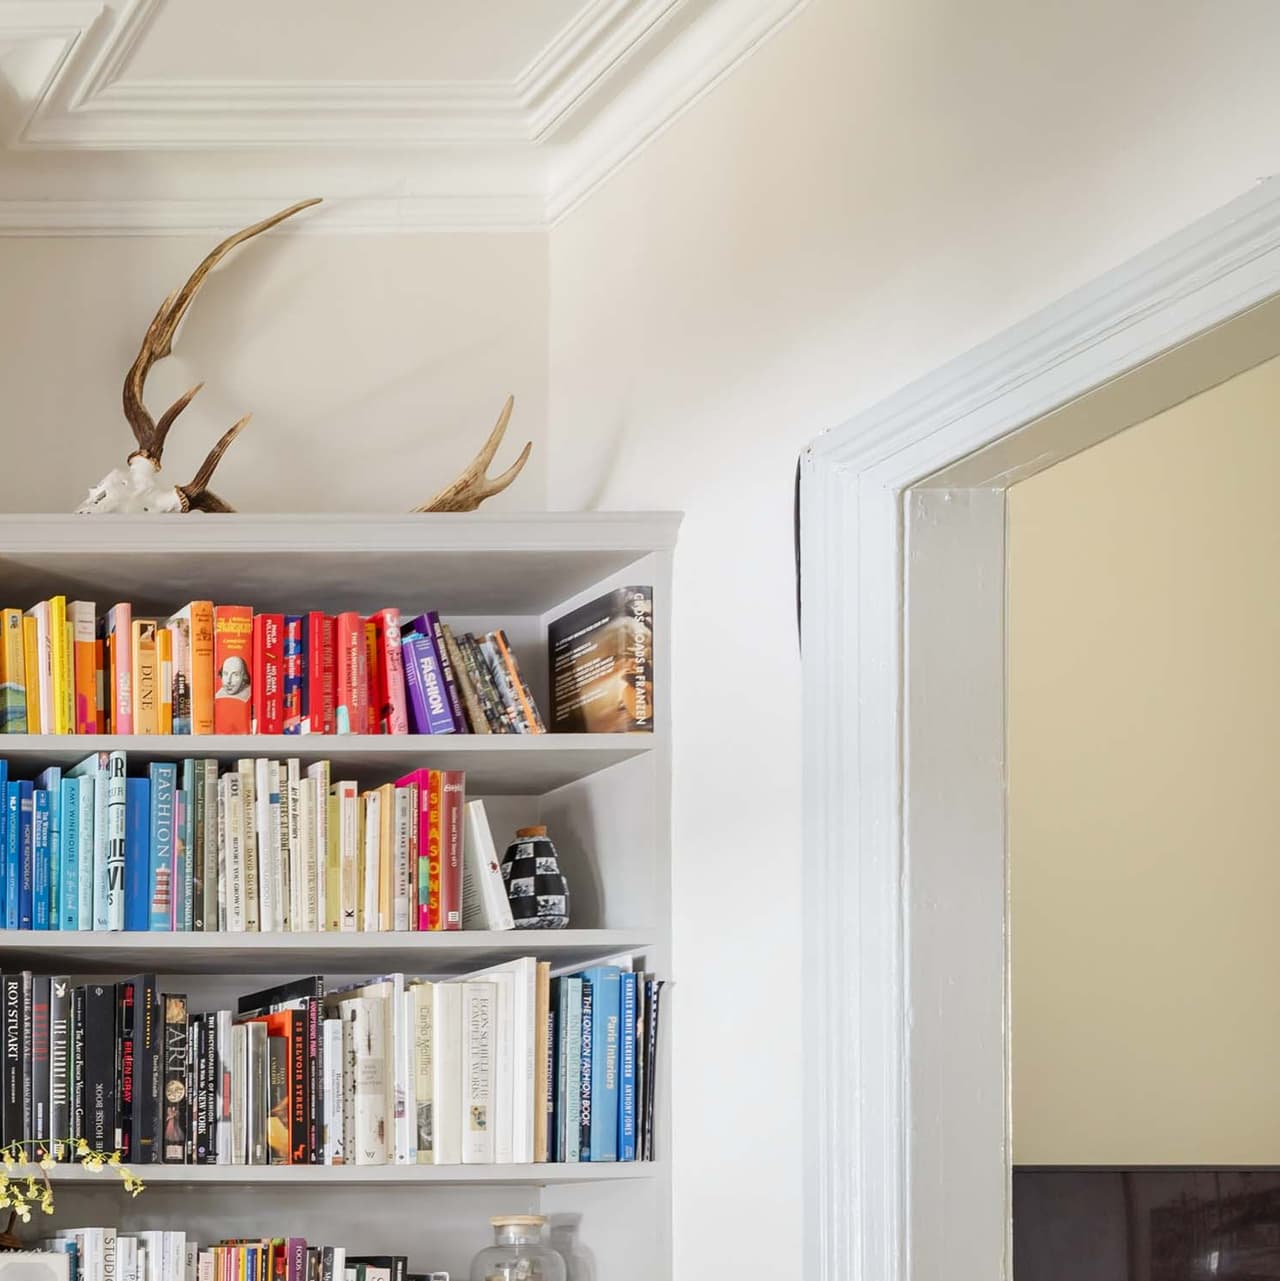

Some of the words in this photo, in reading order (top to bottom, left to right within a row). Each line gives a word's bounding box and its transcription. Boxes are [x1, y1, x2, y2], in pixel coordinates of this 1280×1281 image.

[141, 665, 153, 711] DUNE
[420, 656, 445, 715] FASHION
[68, 786, 76, 806] AMY
[230, 778, 239, 798] 101
[279, 780, 289, 819] DESIGNERS
[156, 769, 172, 859] FASHION
[280, 821, 289, 831] AT
[67, 810, 76, 864] WINEHOUSE
[280, 832, 289, 852] HOME
[247, 848, 255, 872] DAVID
[428, 793, 441, 911] SEASONS
[247, 873, 255, 901] OLIVER
[184, 900, 193, 928] LIVING
[8, 981, 19, 1008] ROY
[582, 996, 592, 1014] THE
[624, 979, 634, 1008] CHARLES
[8, 1010, 19, 1061] STUART
[53, 1019, 68, 1036] THE
[582, 1015, 591, 1056] LONDON
[607, 1015, 618, 1043] Paris
[52, 1040, 68, 1079] PLAYBOY
[168, 1028, 186, 1078] ART
[295, 1036, 304, 1081] BELVOIR
[582, 1057, 591, 1099] FASHION
[605, 1045, 617, 1090] Interiors
[52, 1083, 68, 1106] BOOK
[95, 1083, 104, 1108] BOOK
[123, 1077, 133, 1104] GRAY
[198, 1090, 207, 1111] NEW
[295, 1083, 304, 1124] STREET
[623, 1084, 633, 1114] ANTHONY
[95, 1111, 104, 1139] HOUSE
[197, 1111, 207, 1135] YORK
[582, 1100, 591, 1127] BOOK
[624, 1115, 633, 1136] JONES
[295, 1245, 303, 1271] FOODS
